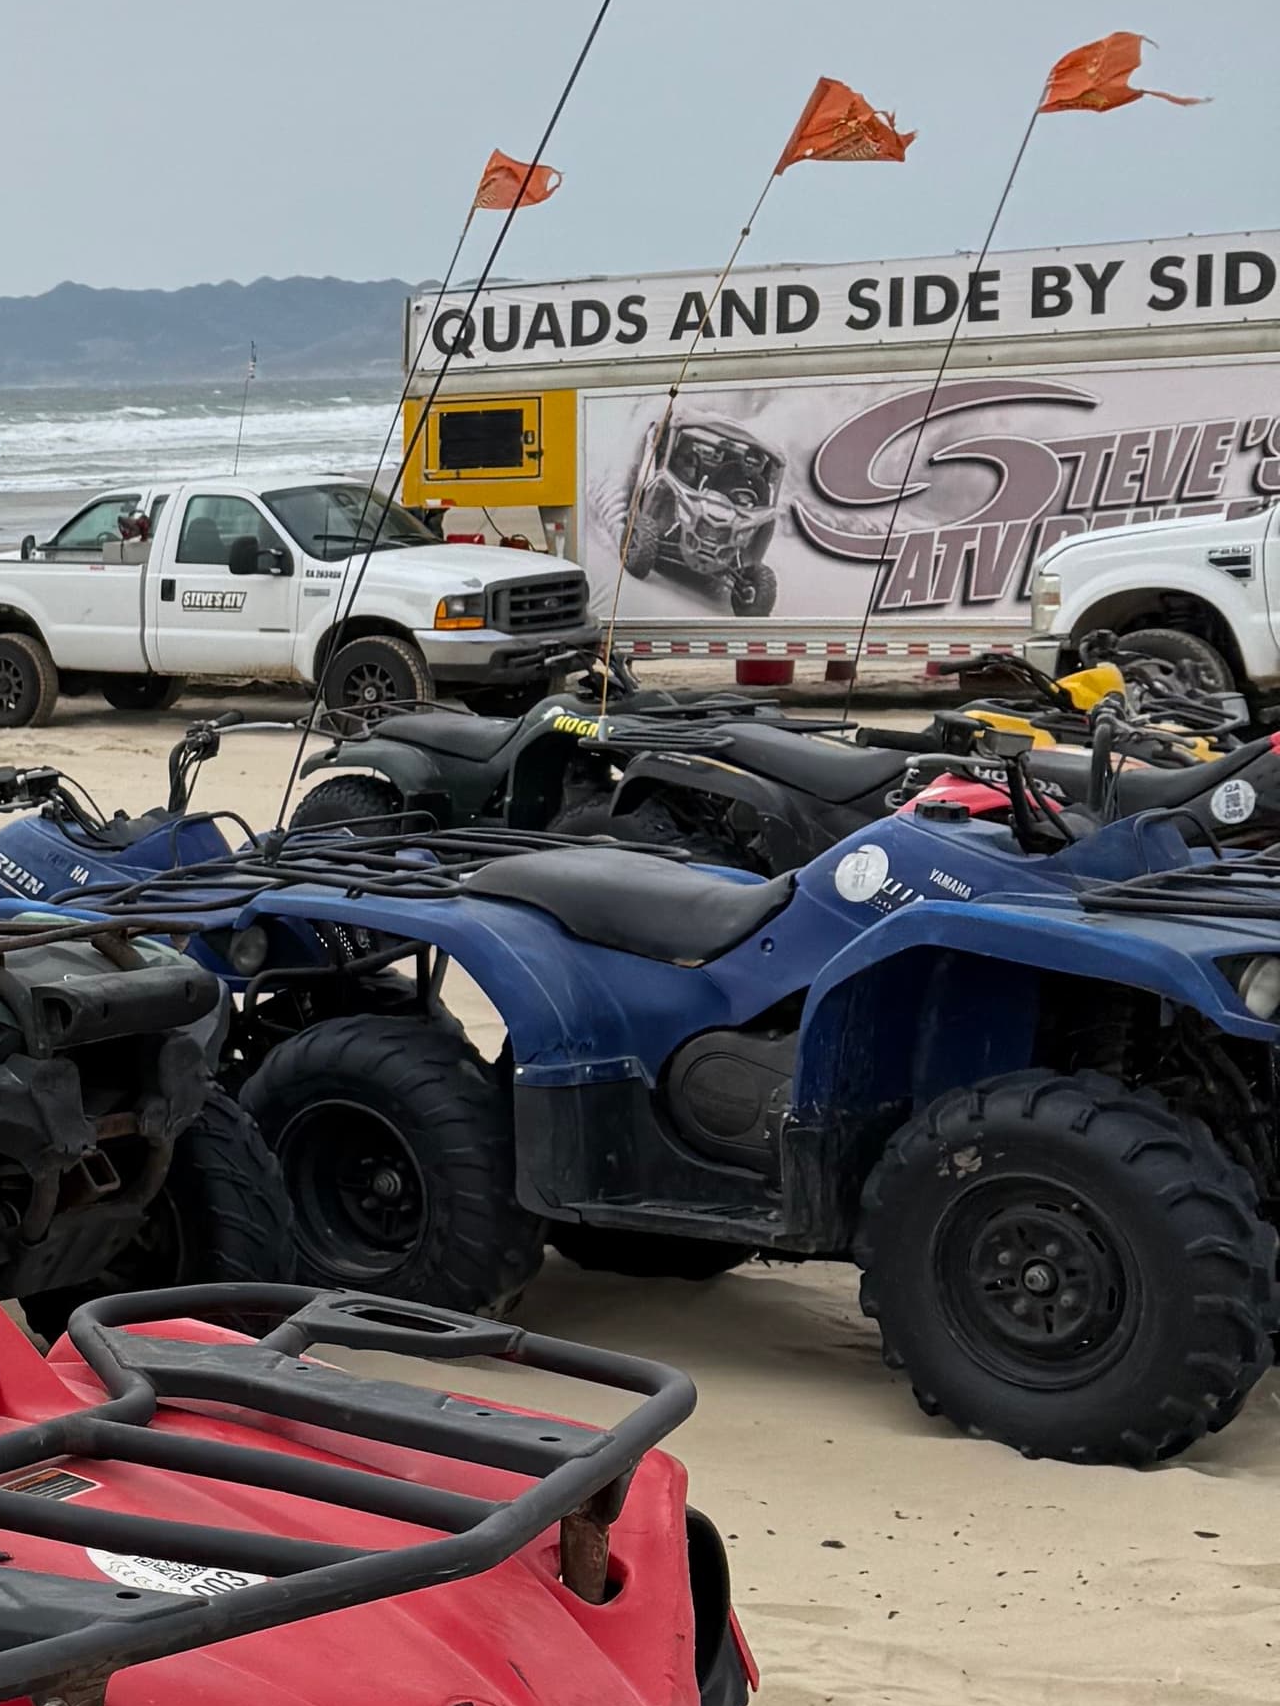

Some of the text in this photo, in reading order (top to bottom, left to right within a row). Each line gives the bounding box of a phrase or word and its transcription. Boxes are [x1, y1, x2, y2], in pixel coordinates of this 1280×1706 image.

[431, 295, 648, 359] QUADS
[669, 284, 820, 341] AND
[845, 269, 1000, 330] SIDE
[1031, 260, 1125, 319] BY
[880, 515, 1040, 611] ATV
[223, 592, 245, 608] ATV
[929, 868, 972, 900] YAMAHA
